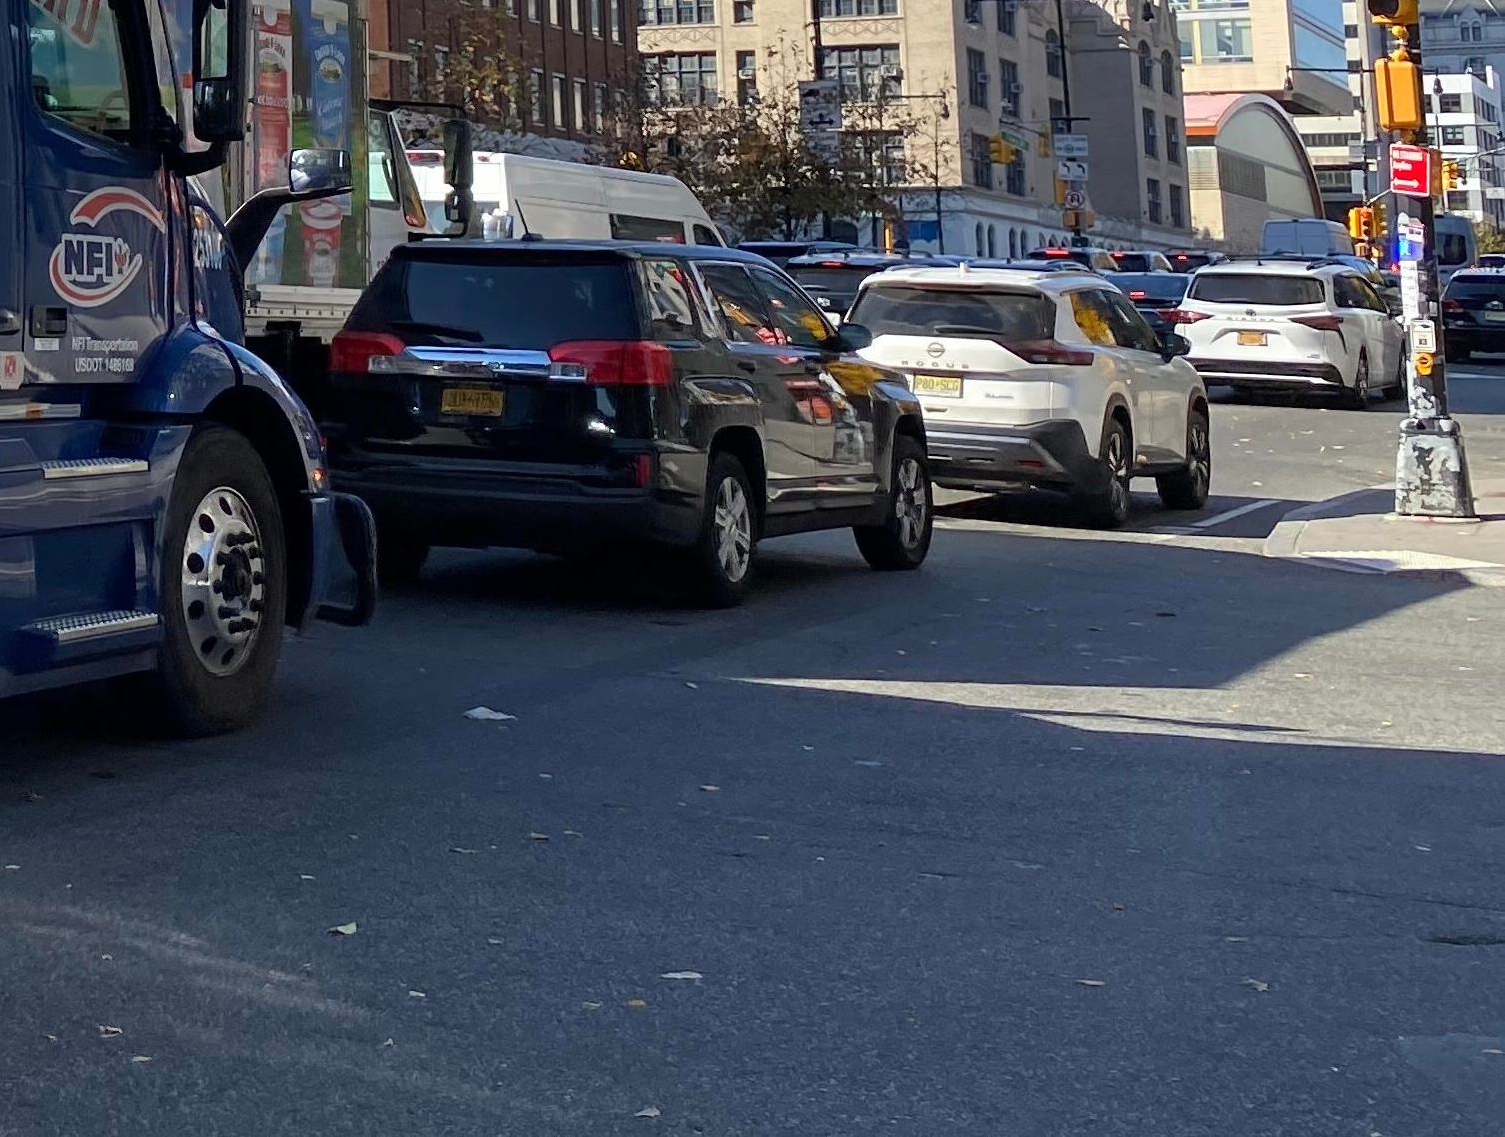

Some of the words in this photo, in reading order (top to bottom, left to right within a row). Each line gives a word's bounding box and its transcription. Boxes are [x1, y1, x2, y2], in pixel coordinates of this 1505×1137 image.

[63, 237, 114, 279] NFI
[71, 336, 85, 351] NFI
[86, 336, 139, 354] Transportation
[75, 357, 103, 373] USDOT
